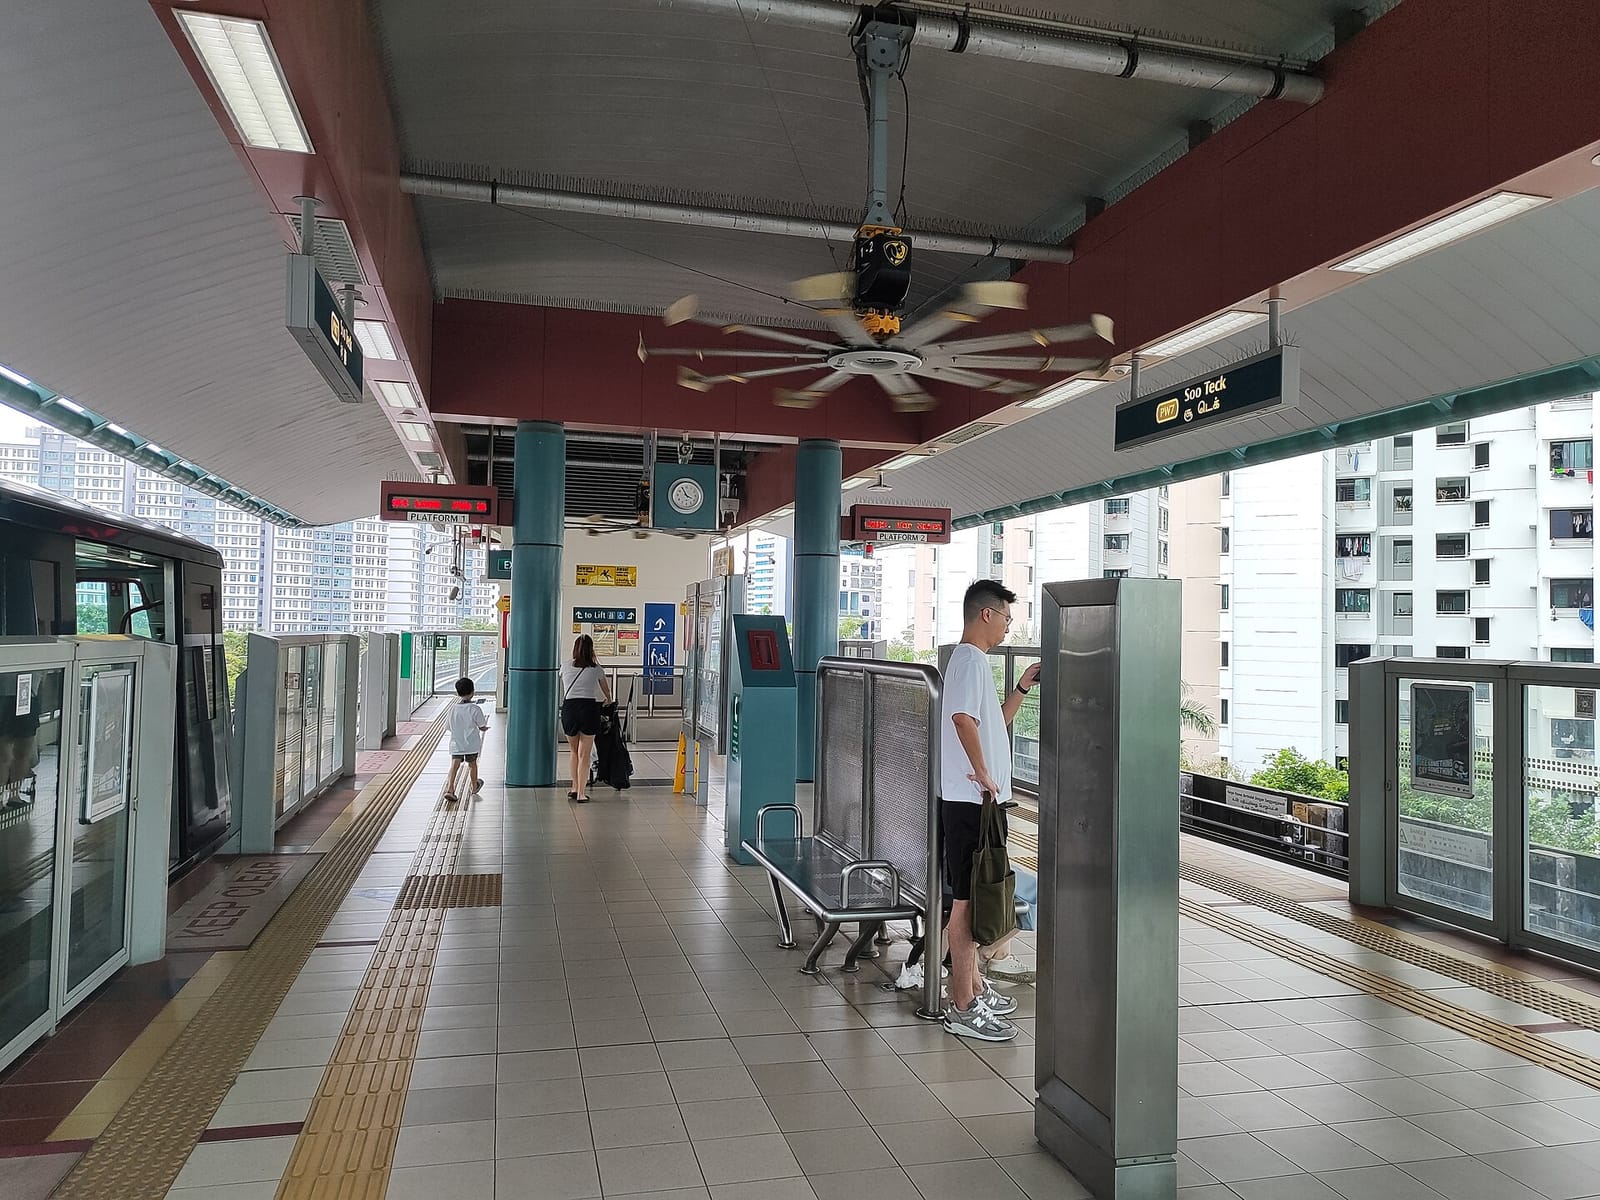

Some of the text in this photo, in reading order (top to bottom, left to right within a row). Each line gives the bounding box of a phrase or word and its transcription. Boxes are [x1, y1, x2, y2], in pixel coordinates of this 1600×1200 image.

[1184, 375, 1227, 402] Soo Teck
[1159, 404, 1175, 418] PW7
[410, 512, 466, 523] PLATFORM 1
[879, 533, 919, 541] PLATFORM
[584, 611, 606, 619] to Lift
[174, 861, 295, 938] KEEP CLEAR
